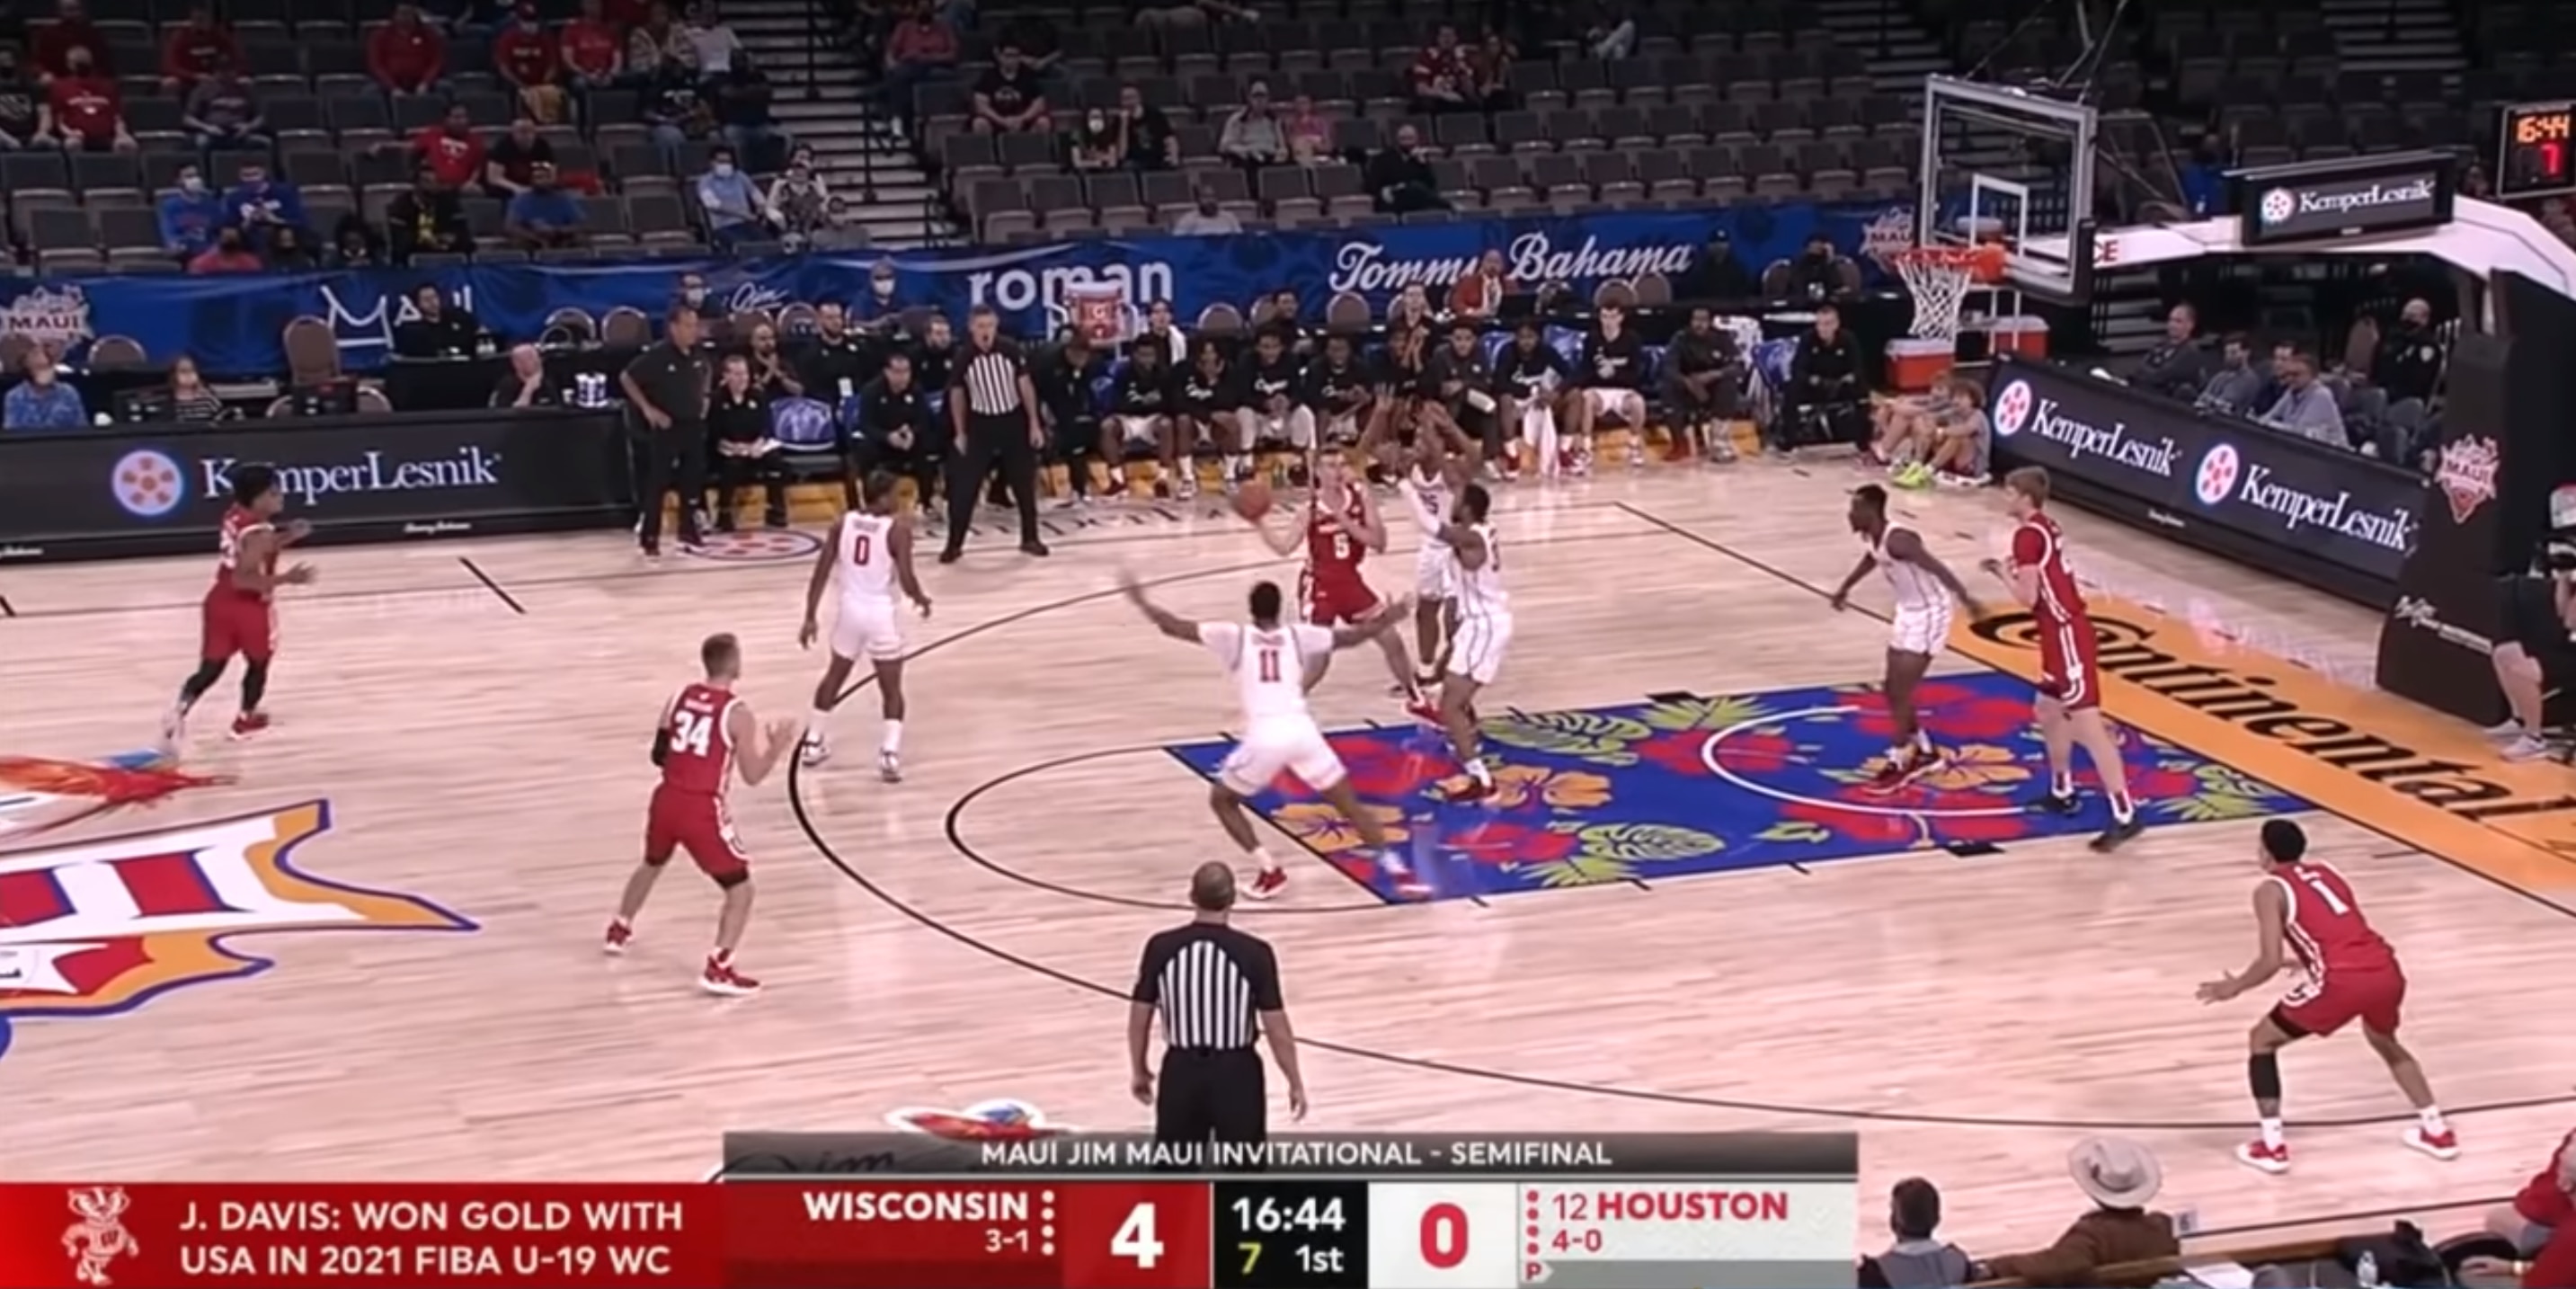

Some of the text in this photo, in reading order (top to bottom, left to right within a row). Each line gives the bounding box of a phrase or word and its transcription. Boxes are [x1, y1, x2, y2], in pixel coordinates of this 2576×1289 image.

[2298, 179, 2434, 213] KemperLesnik
[1507, 231, 1697, 281] Bahama
[8, 316, 79, 330] MAUI
[2030, 399, 2178, 477] KemperLesnik
[200, 446, 498, 505] KmperLesnik
[2446, 458, 2491, 486] MAUI
[2239, 464, 2412, 552] KemperLesnik
[854, 534, 870, 567] 0
[1334, 533, 1349, 559] 5
[1259, 649, 1282, 682] 11
[671, 710, 714, 757] 34
[2310, 879, 2349, 915] 1
